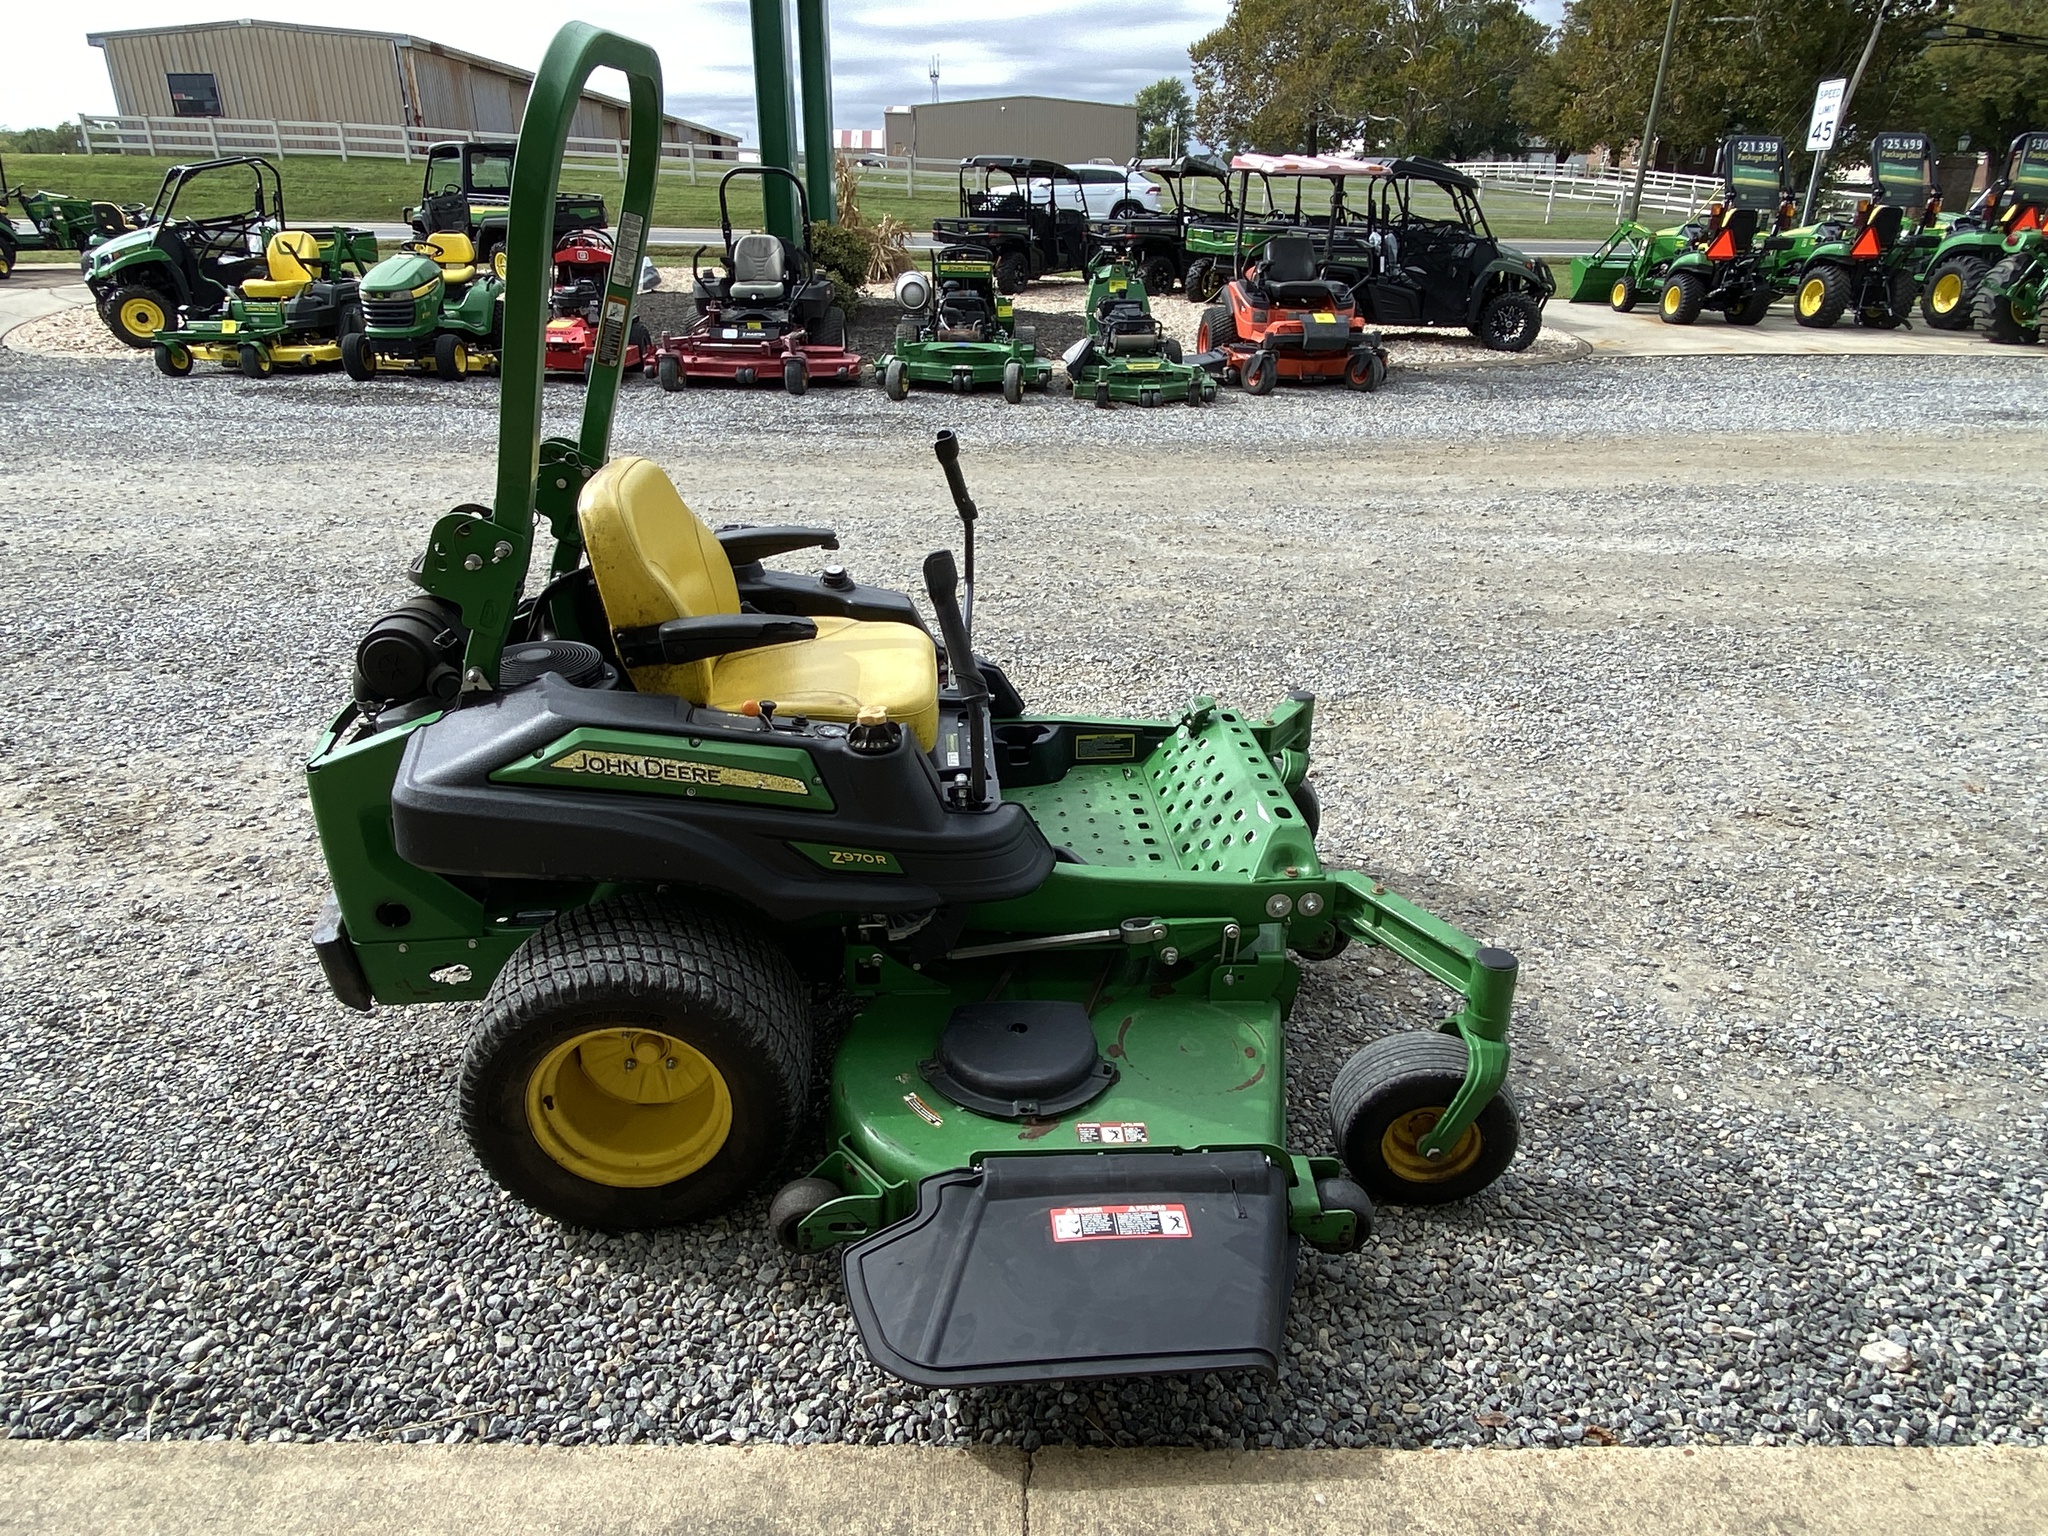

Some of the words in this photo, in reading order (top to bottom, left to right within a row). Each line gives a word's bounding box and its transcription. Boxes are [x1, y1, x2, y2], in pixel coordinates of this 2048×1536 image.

[1819, 88, 1841, 100] SPEED
[1818, 104, 1835, 115] LIMIT
[1811, 120, 1834, 141] 45
[1737, 153, 1762, 163] Package
[1763, 154, 1778, 162] Deal
[1881, 151, 1907, 160] Package
[1908, 151, 1922, 159] Deal
[575, 753, 639, 776] JOHN
[643, 757, 722, 784] DEERE
[829, 851, 887, 864] Z970R
